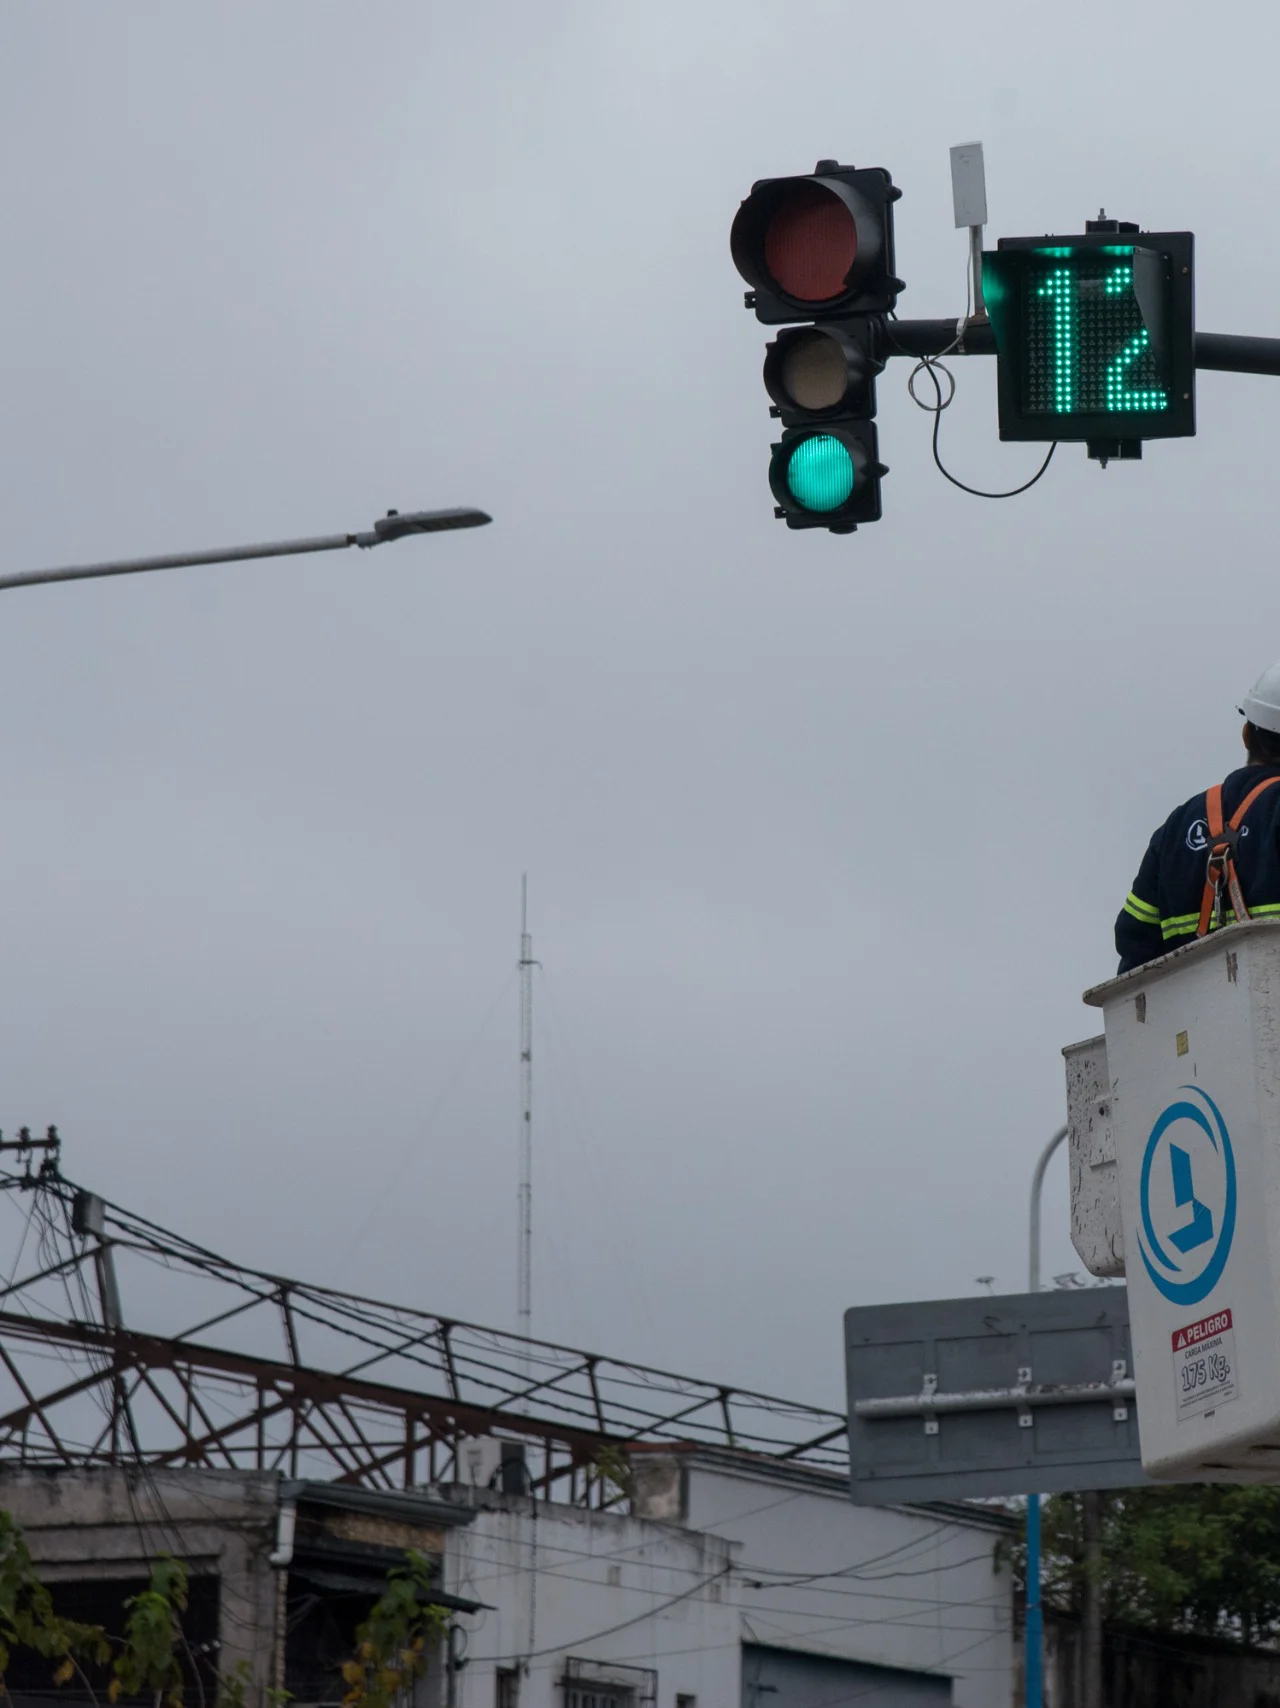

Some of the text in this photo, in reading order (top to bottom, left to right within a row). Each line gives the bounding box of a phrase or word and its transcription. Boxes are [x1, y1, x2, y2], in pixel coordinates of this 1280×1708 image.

[1037, 267, 1169, 413] 12
[1187, 1313, 1228, 1343] PELIGRO
[1184, 1346, 1201, 1359] CARGA
[1182, 1359, 1207, 1392] 175
[1208, 1353, 1231, 1382] Kg.
